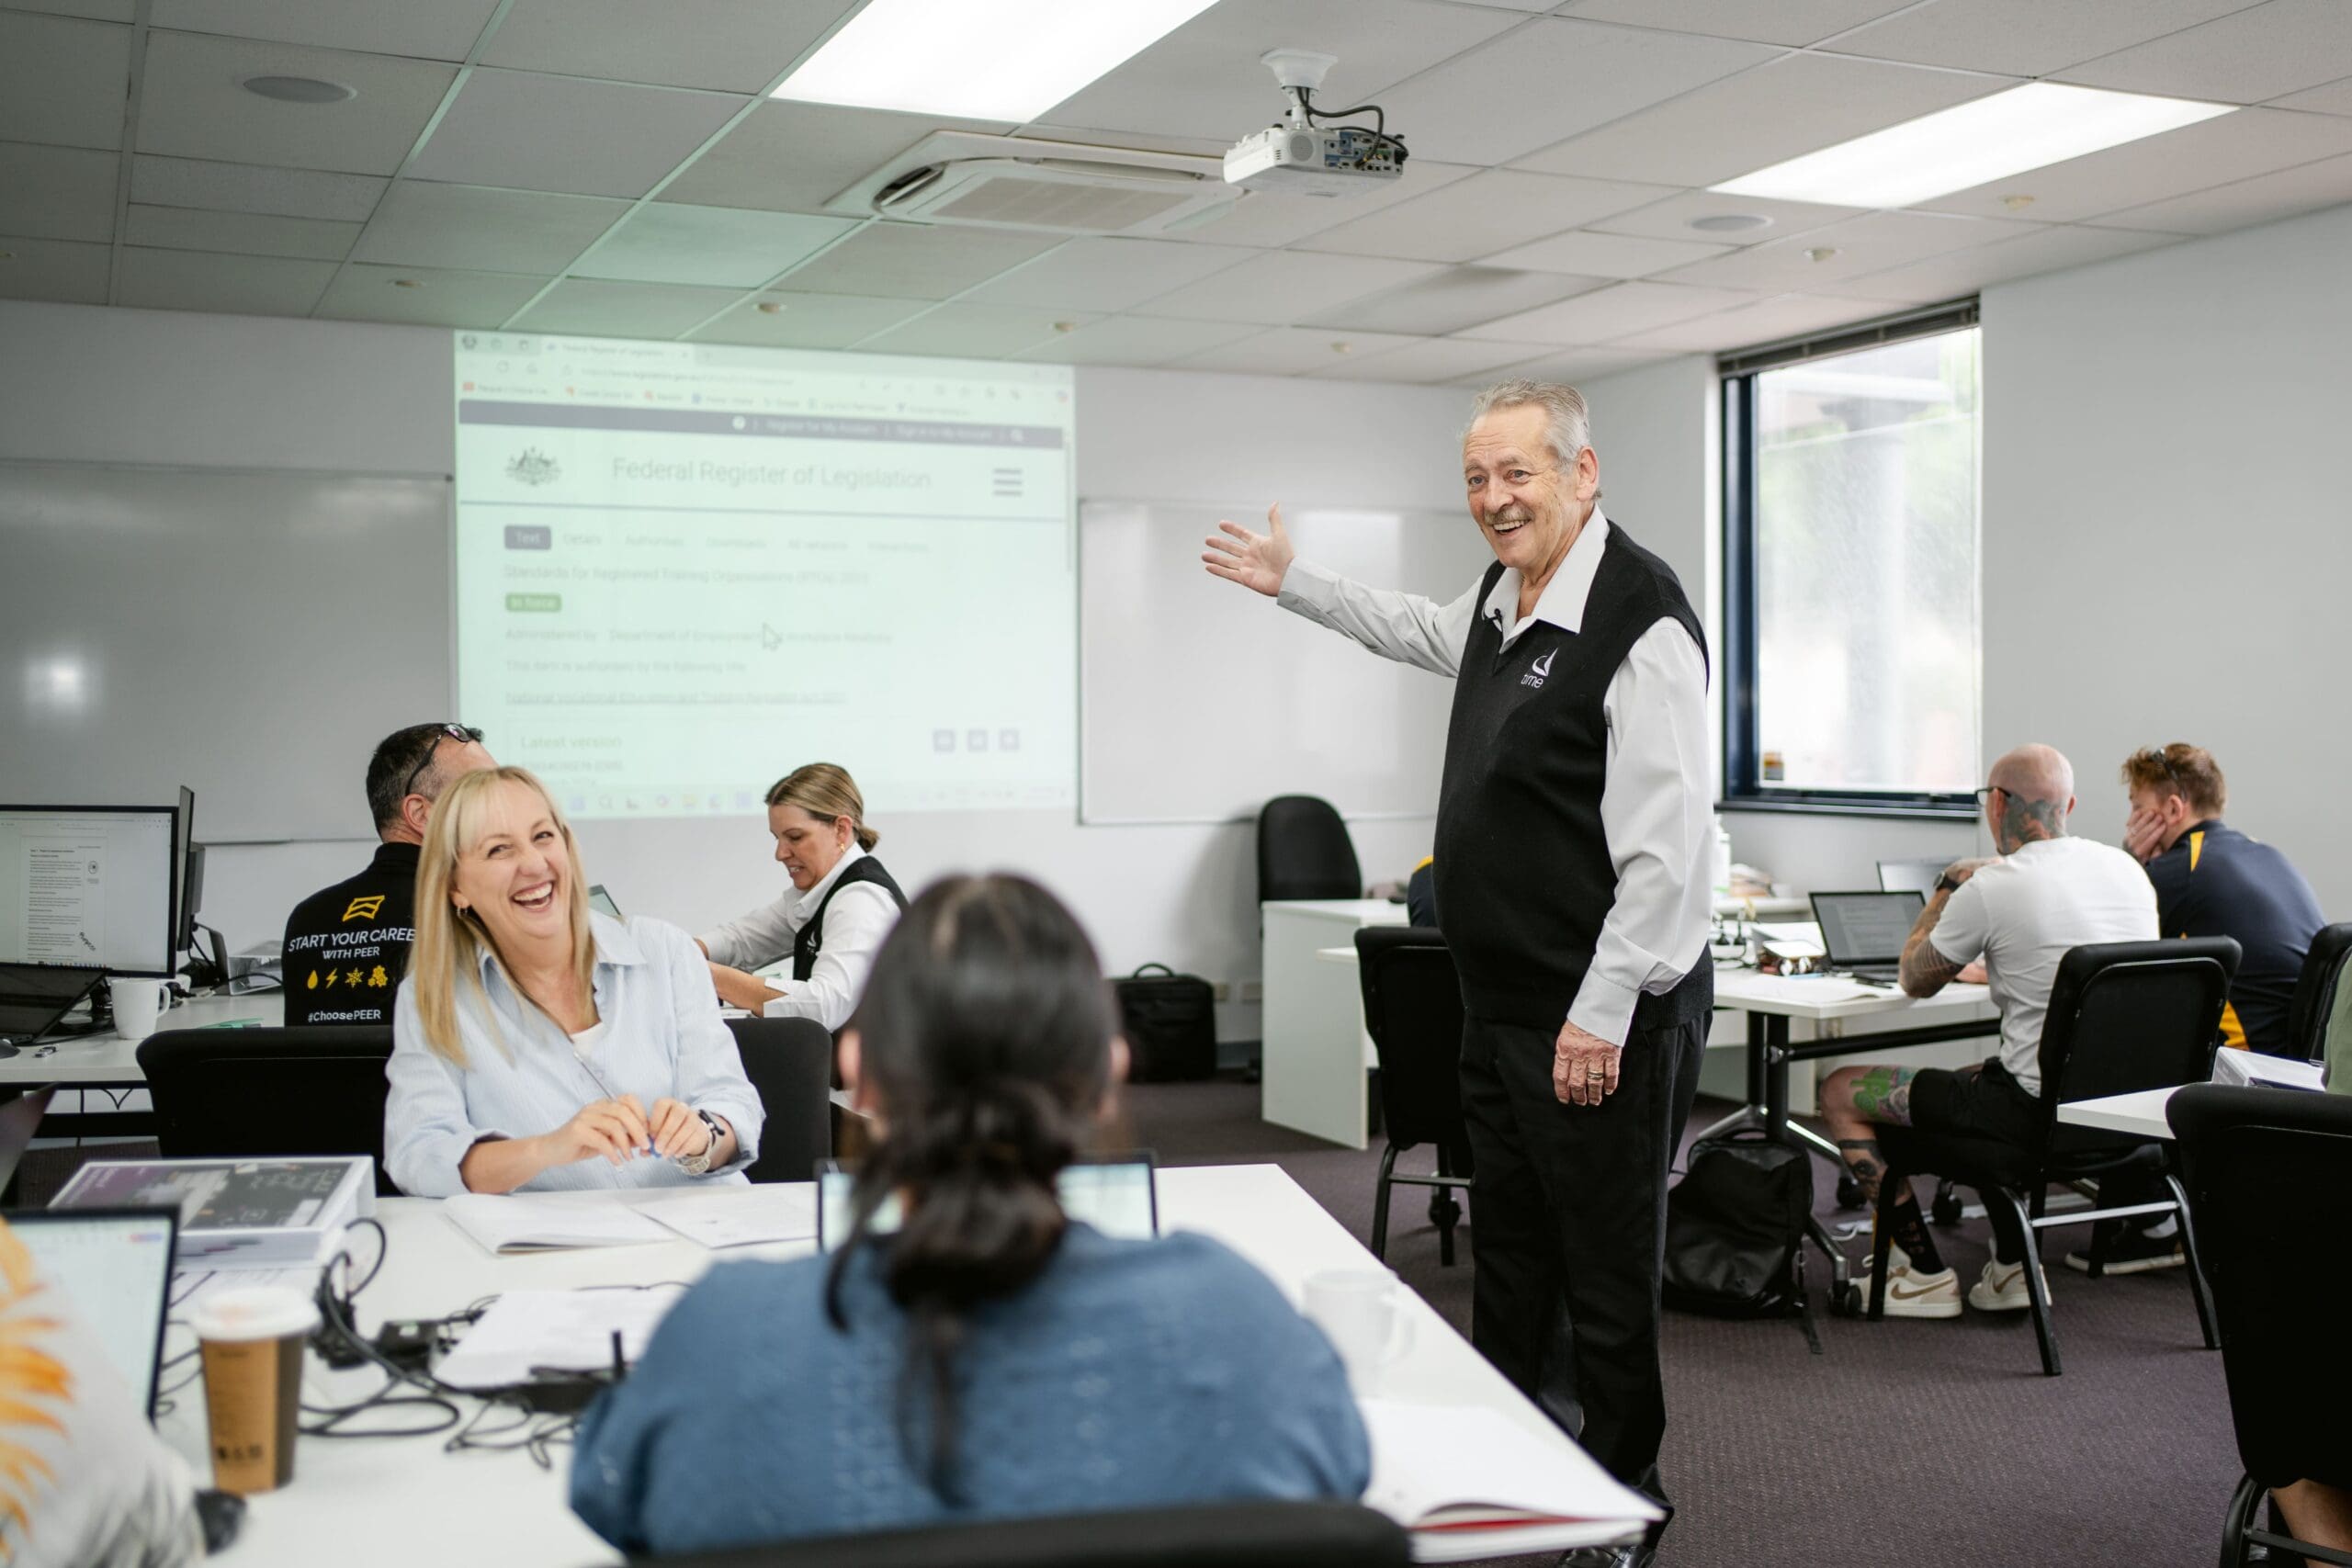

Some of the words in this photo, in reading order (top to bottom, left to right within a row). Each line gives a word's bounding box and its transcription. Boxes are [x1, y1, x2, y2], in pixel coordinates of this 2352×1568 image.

[612, 457, 694, 482] Federal
[699, 459, 787, 488] Register
[793, 462, 817, 485] of
[820, 463, 933, 491] Legislation
[514, 531, 541, 545] Text
[563, 533, 603, 547] Details
[503, 563, 569, 581] Standards
[571, 565, 589, 581] for
[593, 566, 659, 583] Registered
[661, 568, 708, 585] Training
[711, 570, 794, 586] Organisations
[511, 597, 523, 609] In
[525, 596, 557, 609] force
[505, 629, 582, 641] Administered
[609, 629, 676, 643] Department
[506, 660, 530, 671] This
[520, 735, 565, 750] Latest
[569, 735, 623, 750] version
[288, 933, 328, 953] START
[331, 931, 369, 946] YOUR
[369, 927, 416, 942] CAREE
[322, 948, 352, 960] WITH
[354, 946, 380, 958] PEER
[308, 1009, 381, 1022] #ChoosePEER
